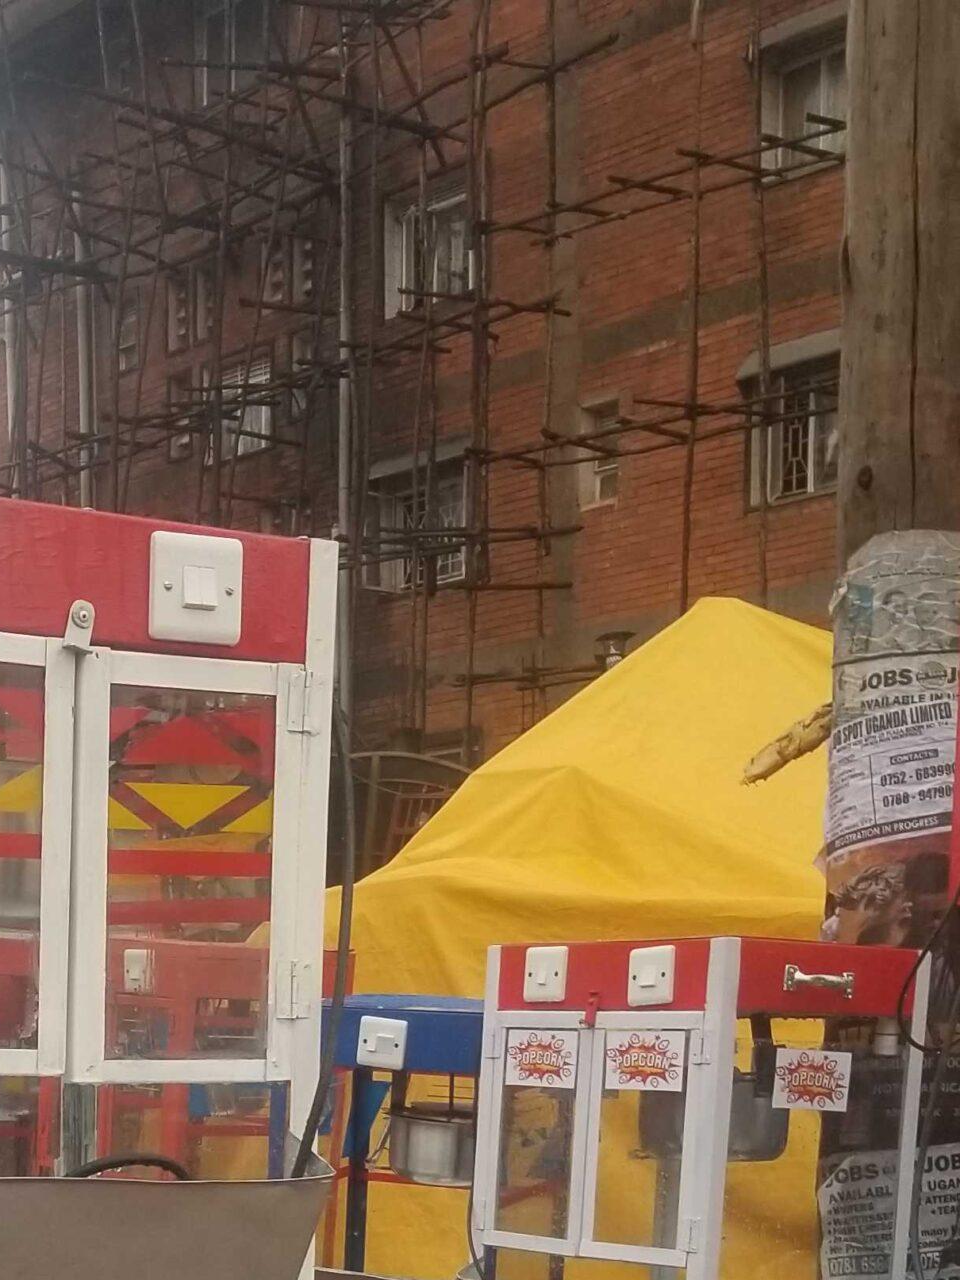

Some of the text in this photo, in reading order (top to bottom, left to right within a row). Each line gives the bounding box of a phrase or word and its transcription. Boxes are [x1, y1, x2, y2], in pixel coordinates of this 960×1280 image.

[859, 668, 914, 692] JOBS
[860, 694, 926, 711] AVAILABLE
[929, 692, 944, 702] IN
[842, 721, 863, 744] SPOT
[865, 709, 909, 735] UGANDA
[909, 701, 952, 725] LIMITED
[880, 771, 907, 787] 0752
[882, 824, 893, 834] IN
[516, 1051, 565, 1068] POPCORN
[616, 1052, 671, 1070] POPCORN
[785, 1071, 837, 1090] POPCORN
[923, 1153, 960, 1173] JOB
[829, 1185, 892, 1205] AVAILABL
[920, 1251, 941, 1270] 075
